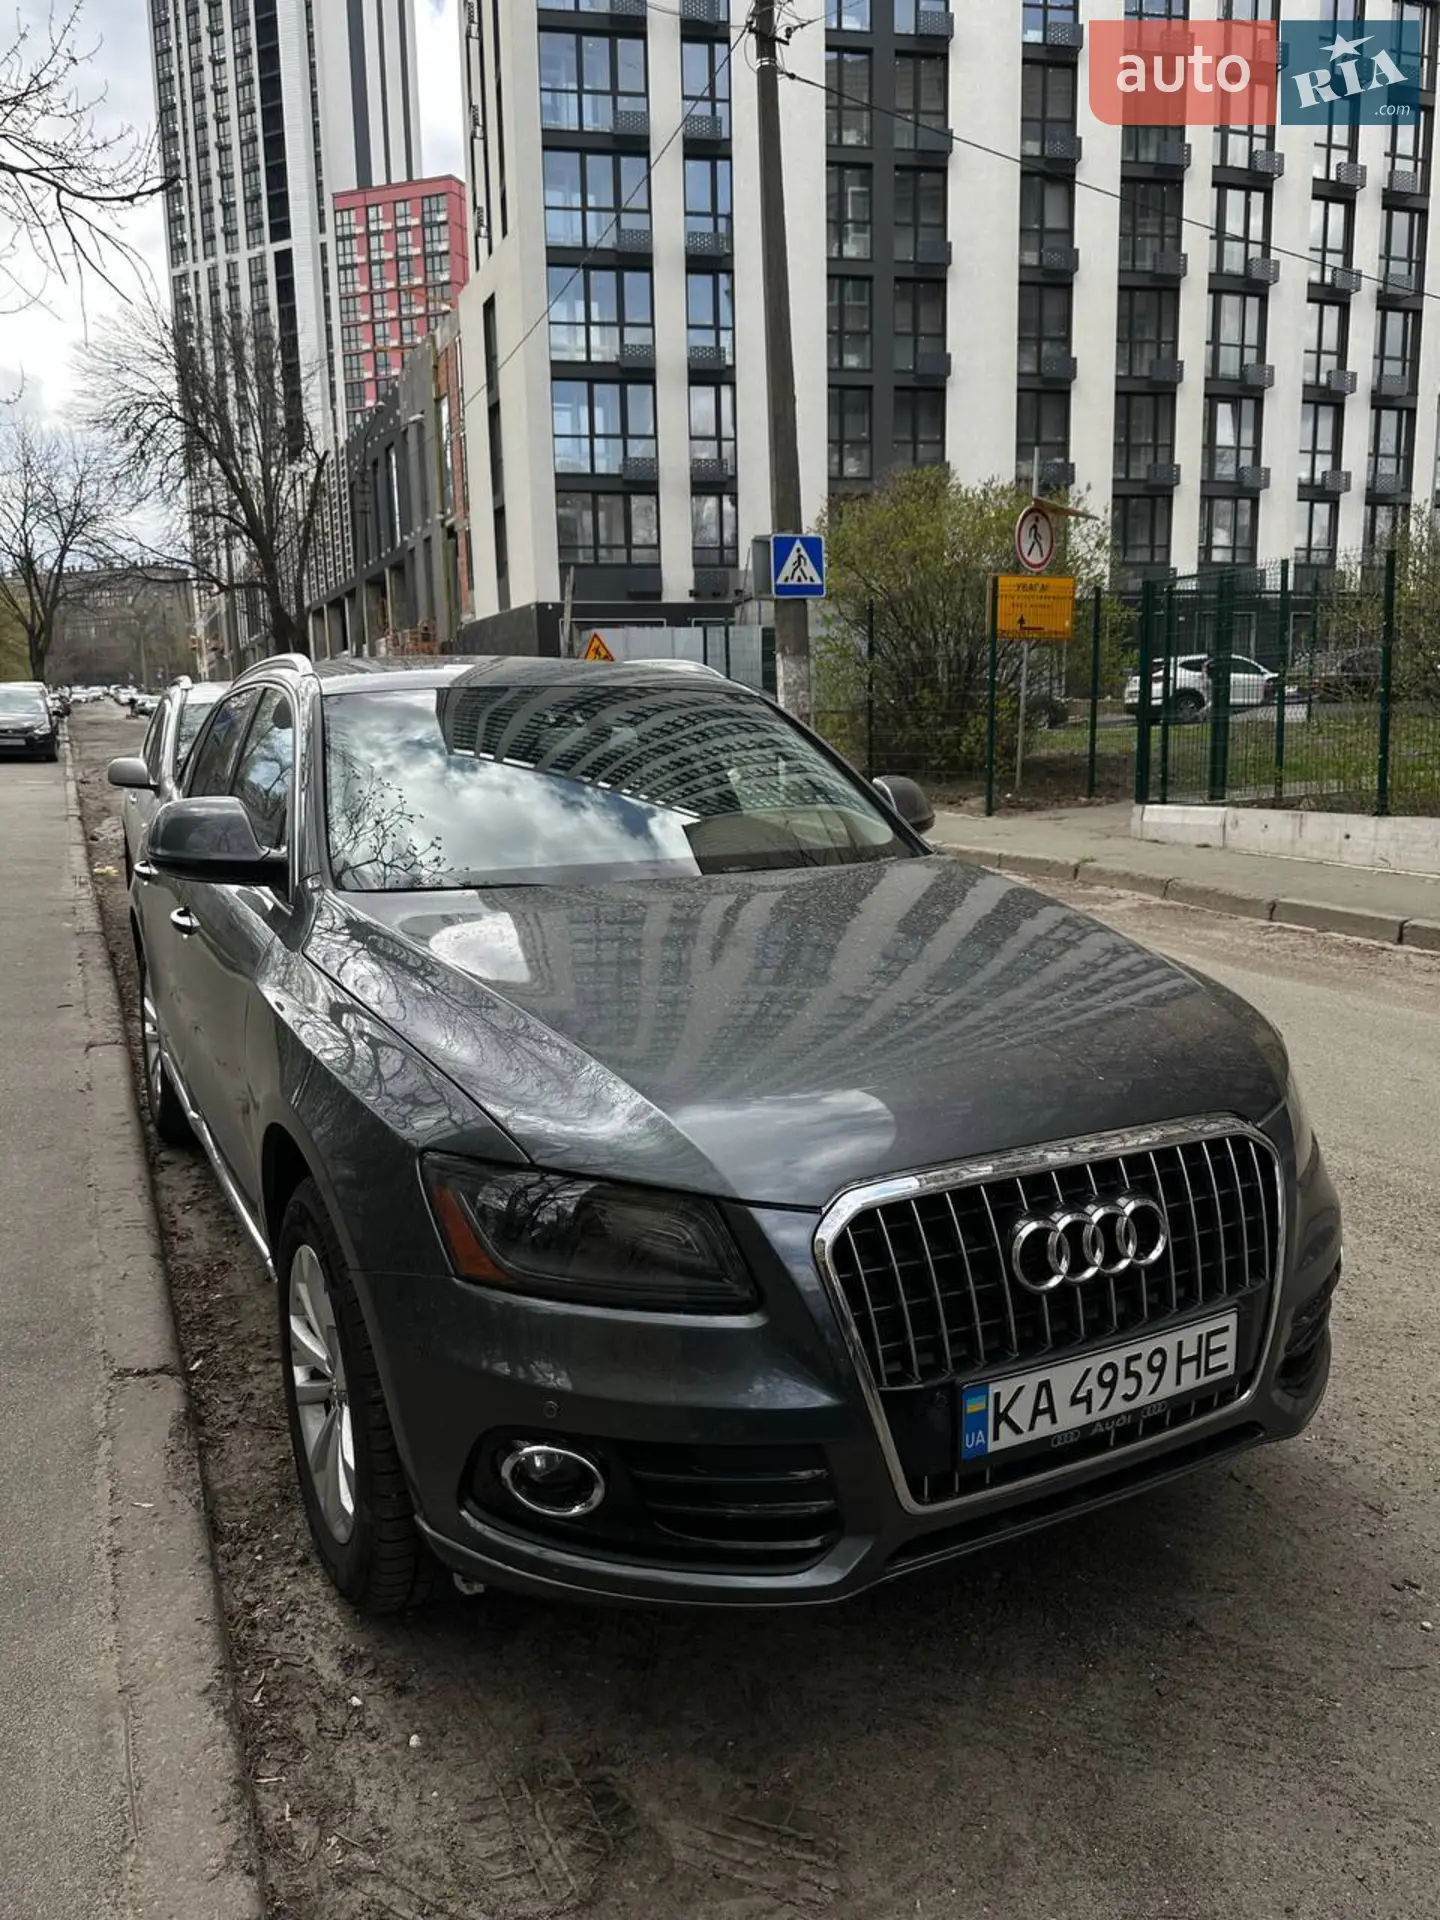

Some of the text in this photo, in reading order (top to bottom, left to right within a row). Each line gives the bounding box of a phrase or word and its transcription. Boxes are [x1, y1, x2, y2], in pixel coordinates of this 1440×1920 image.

[992, 1325, 1230, 1442] KA 4959 HE
[1090, 1414, 1132, 1435] Audi
[965, 1430, 986, 1449] UA
